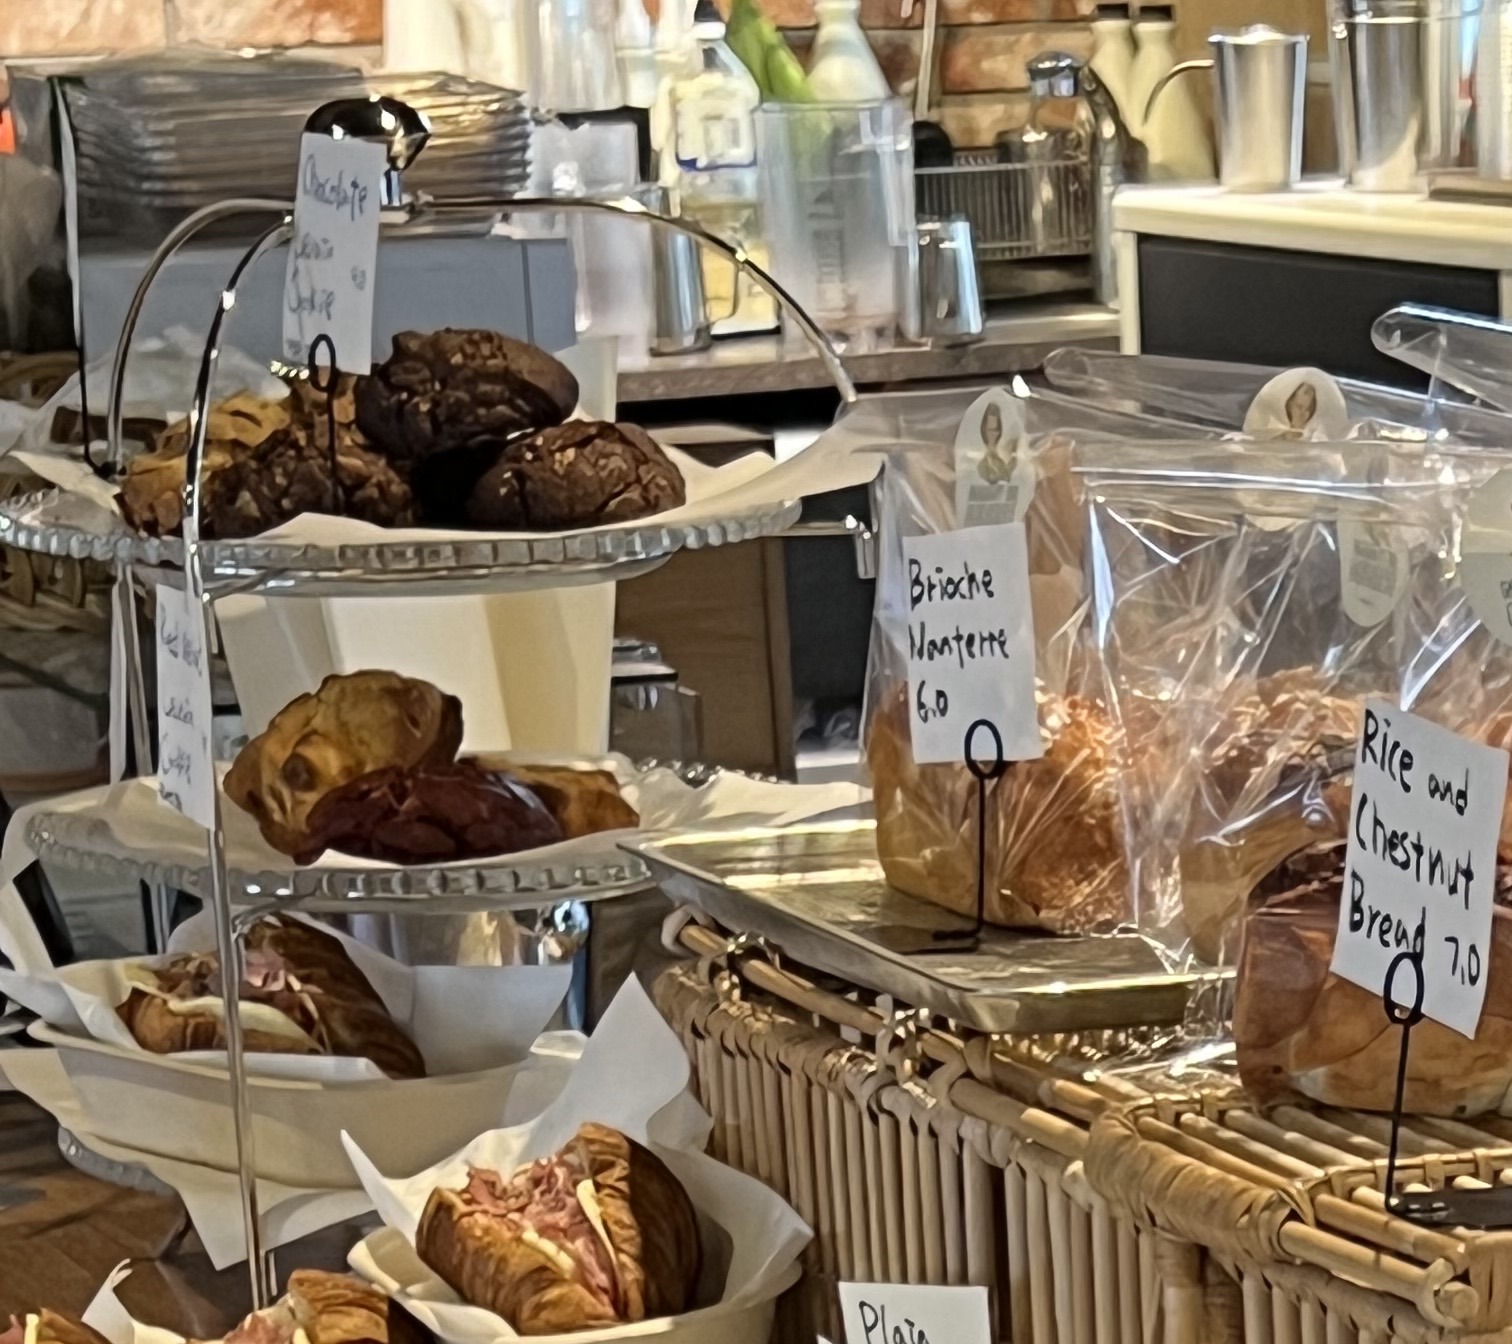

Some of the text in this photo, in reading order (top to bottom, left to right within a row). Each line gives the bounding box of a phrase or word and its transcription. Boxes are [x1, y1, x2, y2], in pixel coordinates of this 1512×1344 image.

[917, 680, 949, 723] 6.0
[1361, 708, 1469, 816] Rice and
[1355, 792, 1475, 911] Chestnut
[1349, 869, 1481, 987] Bread 7.0
